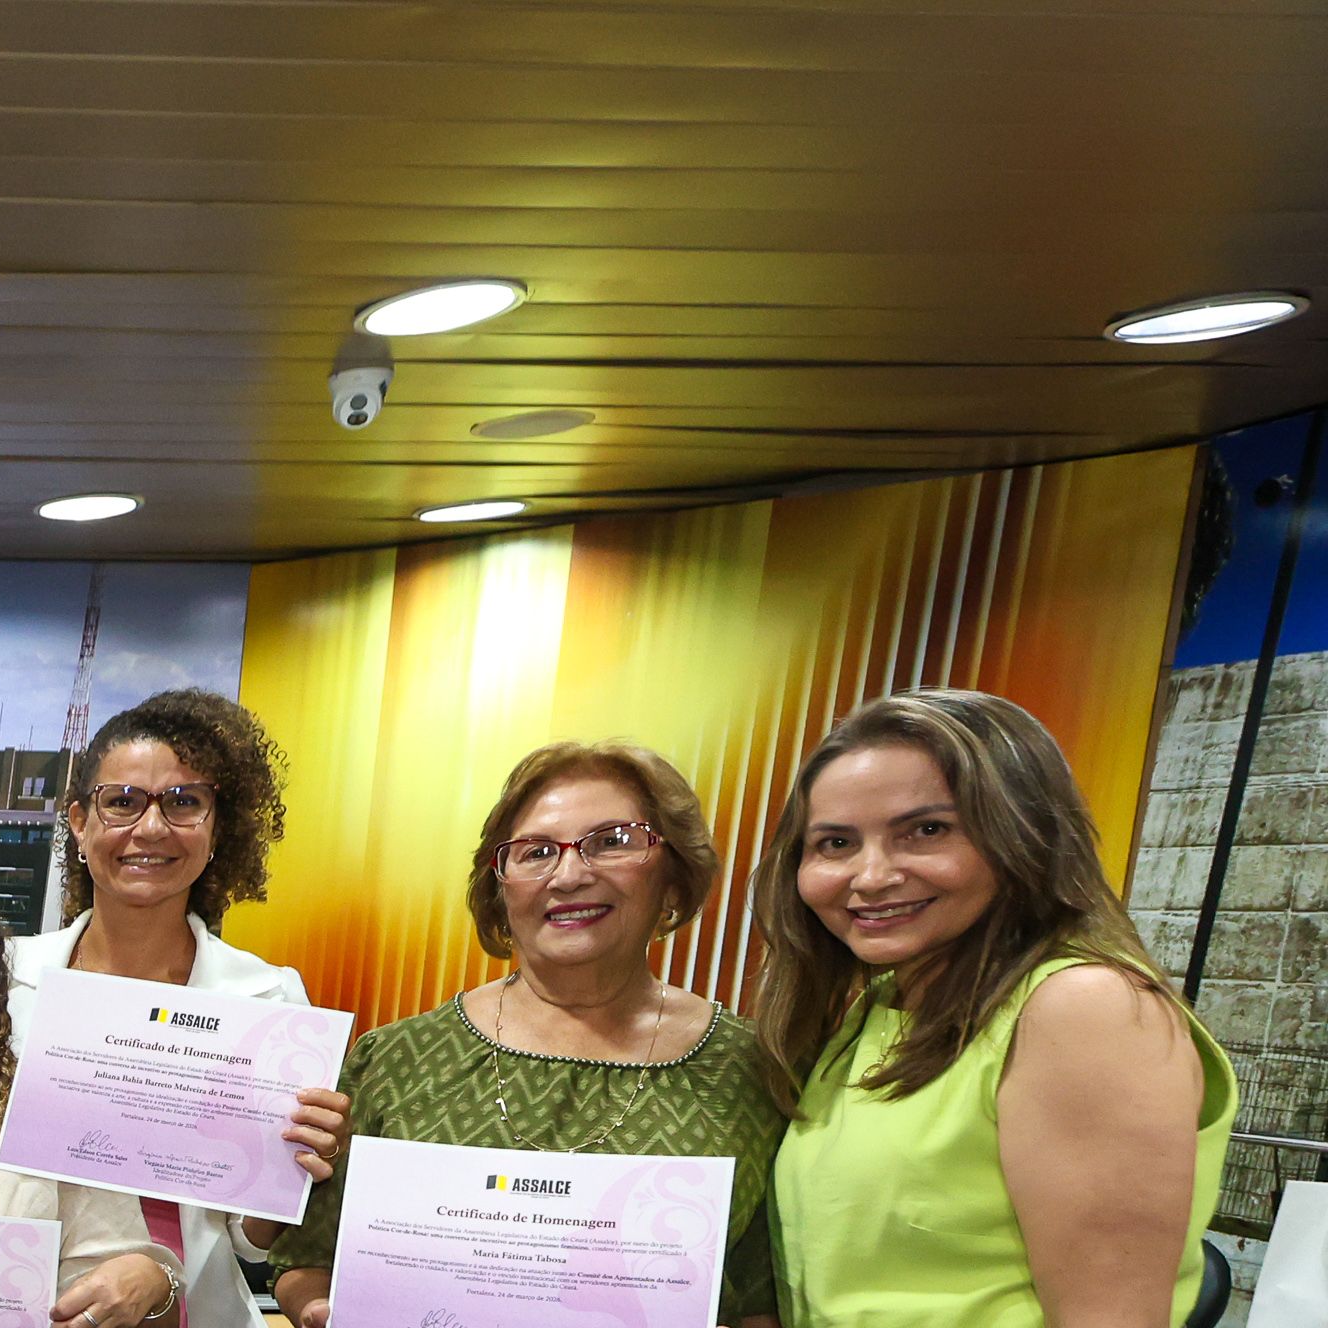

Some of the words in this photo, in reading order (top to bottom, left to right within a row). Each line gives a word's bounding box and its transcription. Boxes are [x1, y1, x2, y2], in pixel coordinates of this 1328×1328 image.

[170, 1012, 221, 1031] ASSALCE
[105, 1035, 165, 1052] Certificado
[167, 1044, 181, 1054] de
[183, 1046, 252, 1066] Homenagem
[93, 1070, 120, 1081] Juliana
[122, 1075, 143, 1084] Bahia
[145, 1078, 173, 1089] Barreto
[174, 1083, 207, 1095] Malveira
[208, 1088, 218, 1096] de
[219, 1090, 245, 1100] Lemos
[512, 1178, 572, 1195] ASSALCE
[436, 1206, 509, 1221] Certificado
[512, 1213, 528, 1223] de
[532, 1214, 616, 1230] Homenagem
[472, 1249, 499, 1258] Maria
[502, 1252, 533, 1261] Fátima
[535, 1254, 567, 1264] Tabosa
